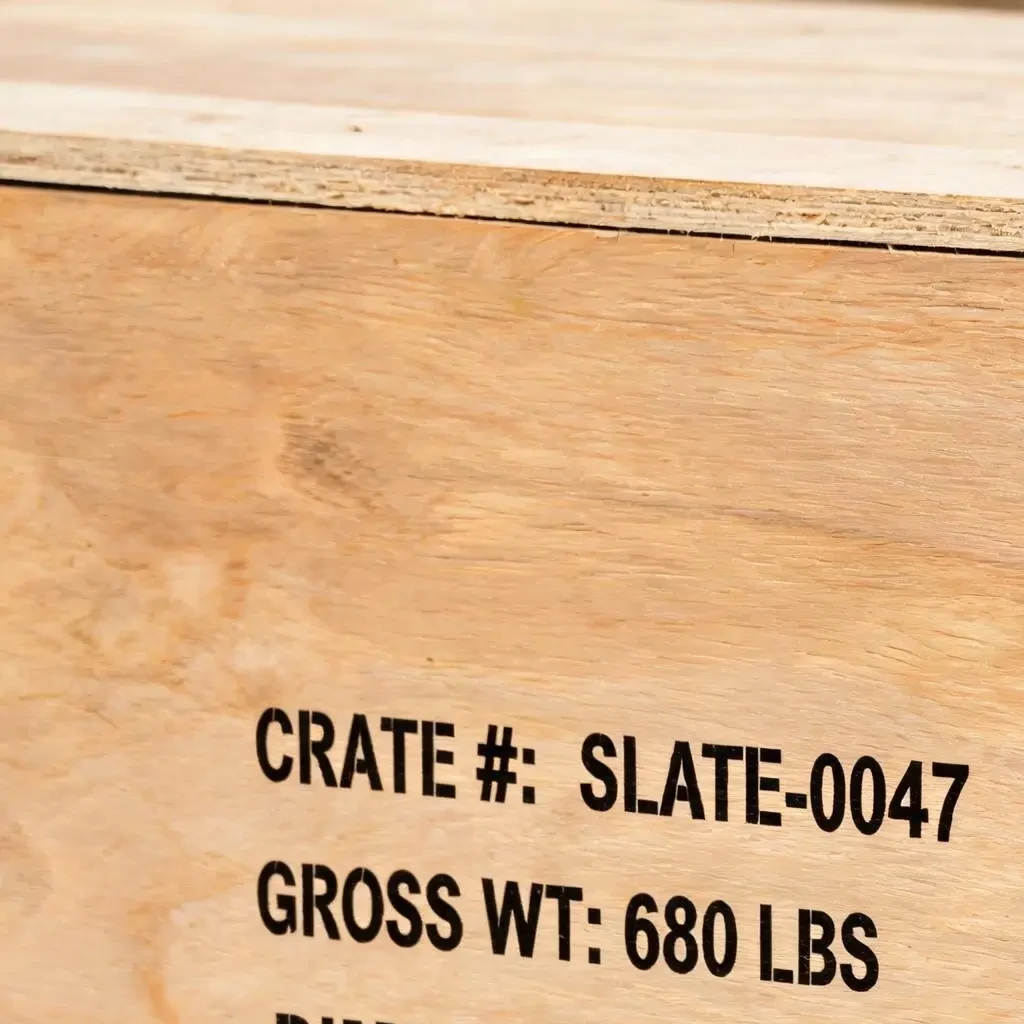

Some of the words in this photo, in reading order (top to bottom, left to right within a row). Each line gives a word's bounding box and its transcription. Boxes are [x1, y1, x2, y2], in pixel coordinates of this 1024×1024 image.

[256, 707, 456, 799] CRATE
[476, 724, 536, 804] #:
[580, 732, 970, 843] SLATE-0047
[257, 860, 463, 951] GROSS
[481, 878, 602, 966] WT:
[624, 893, 738, 978] 680
[759, 904, 879, 993] LBS
